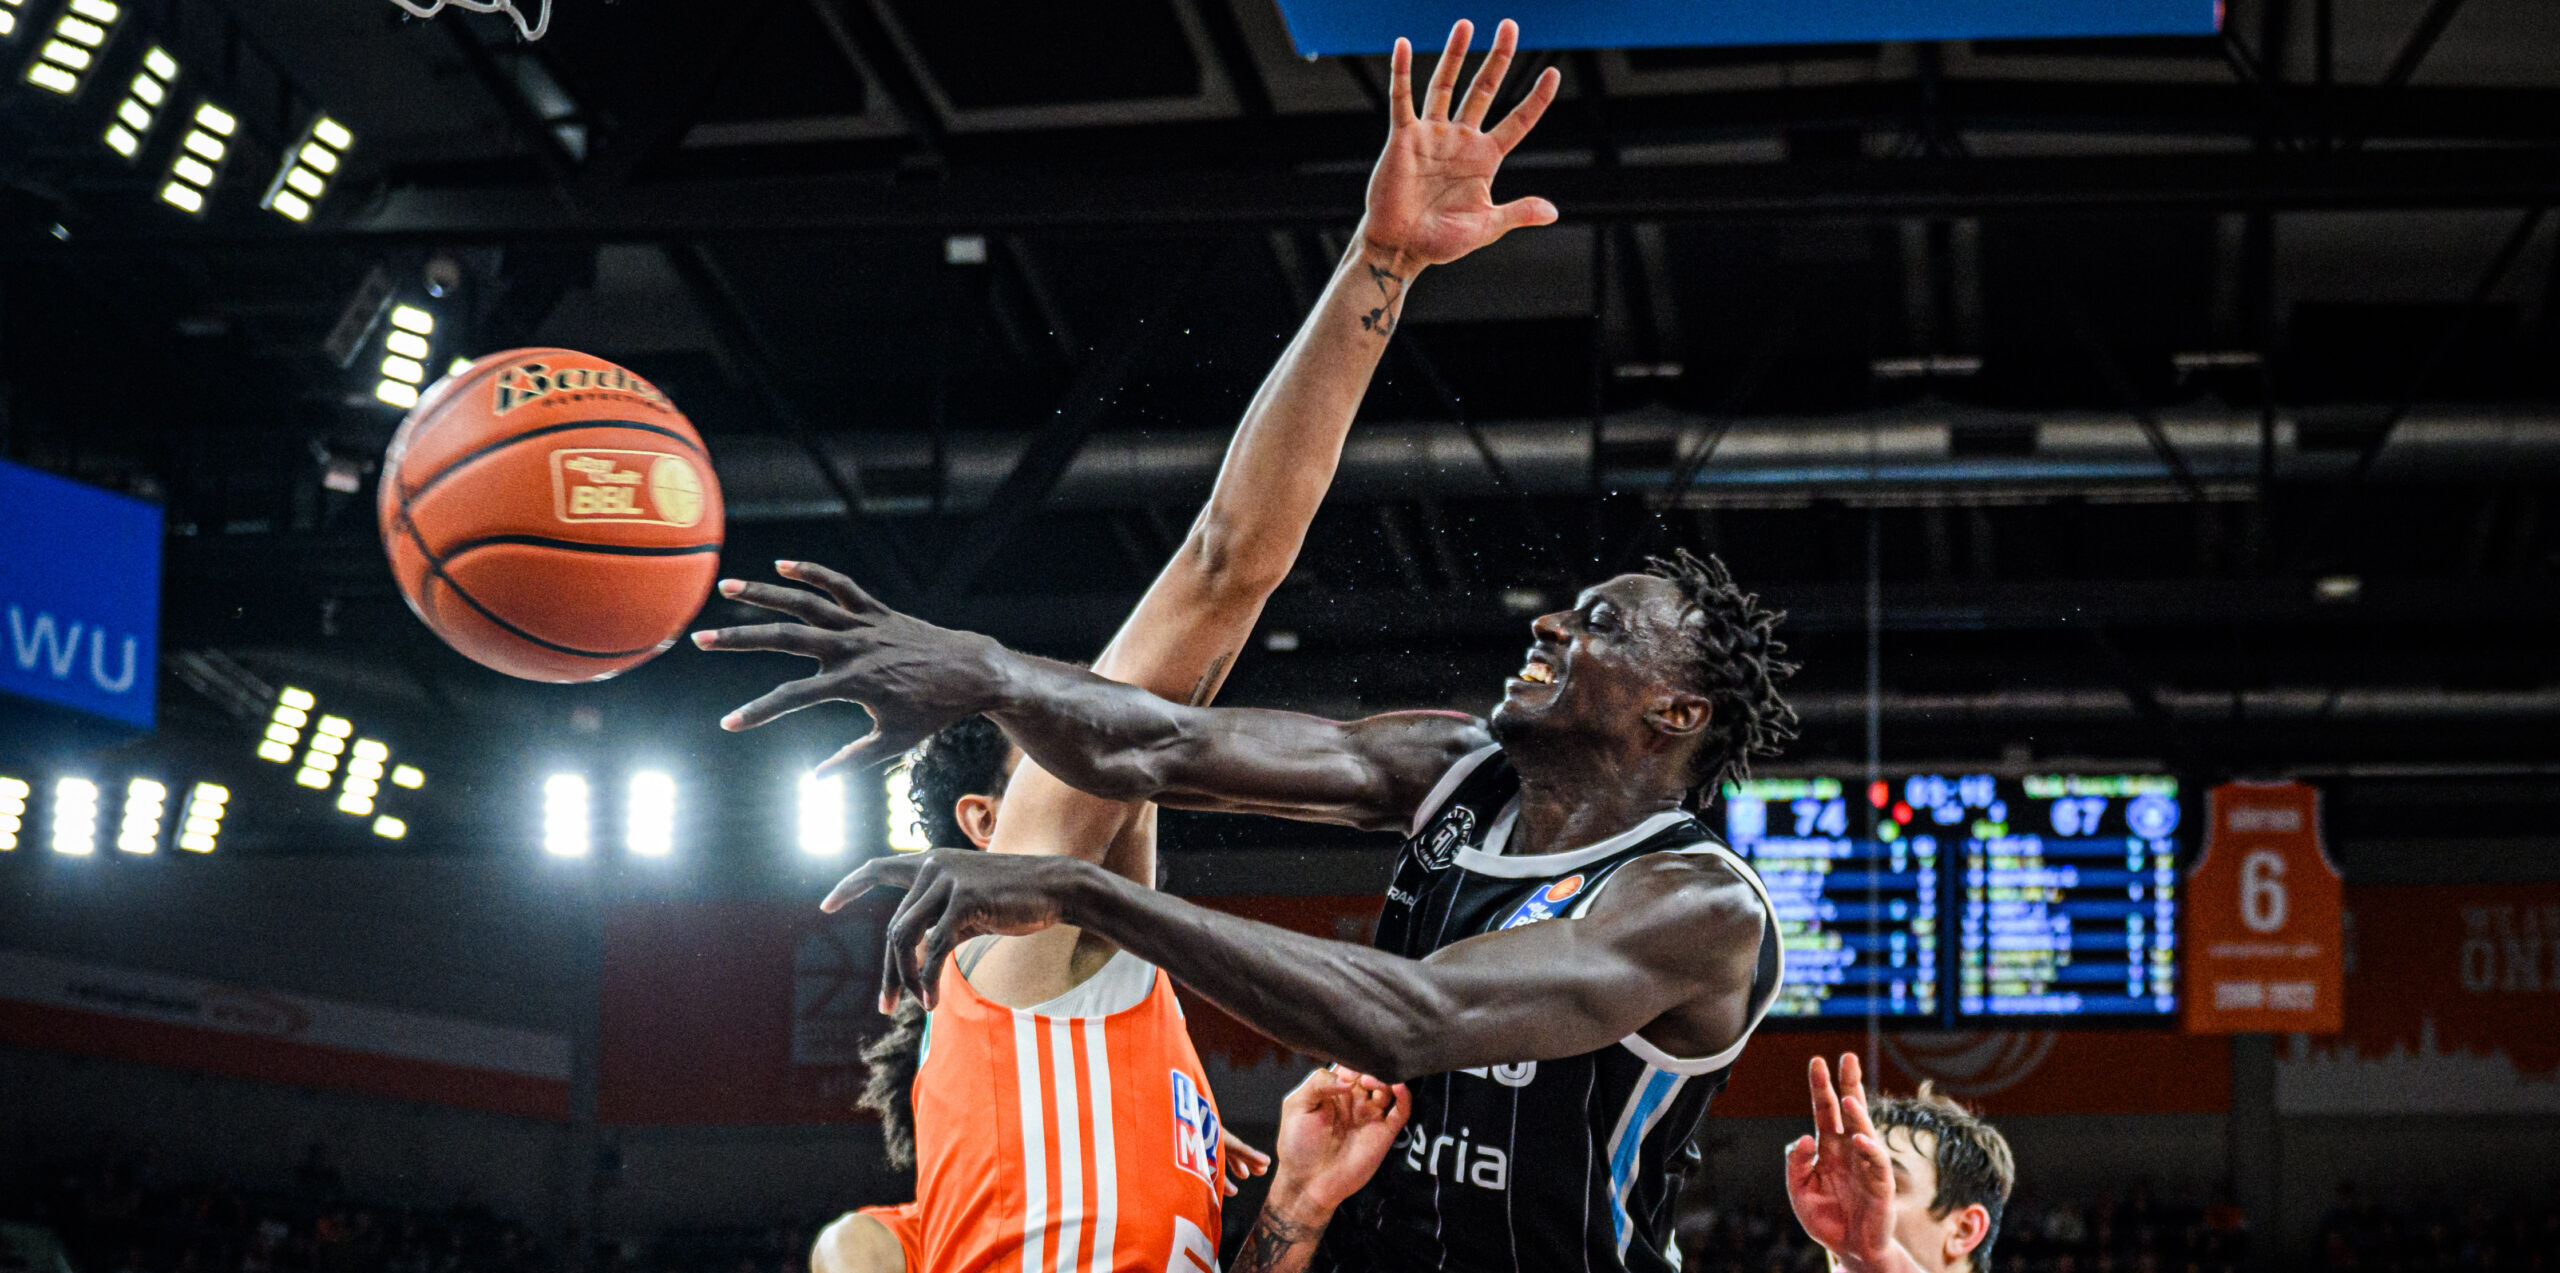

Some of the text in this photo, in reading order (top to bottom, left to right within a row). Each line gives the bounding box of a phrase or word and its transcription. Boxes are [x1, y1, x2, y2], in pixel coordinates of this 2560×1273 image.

[570, 486, 644, 514] BBL
[5, 606, 136, 693] WU
[1791, 797, 1848, 837] 74
[2051, 796, 2108, 837] 67
[2239, 850, 2289, 932] 6
